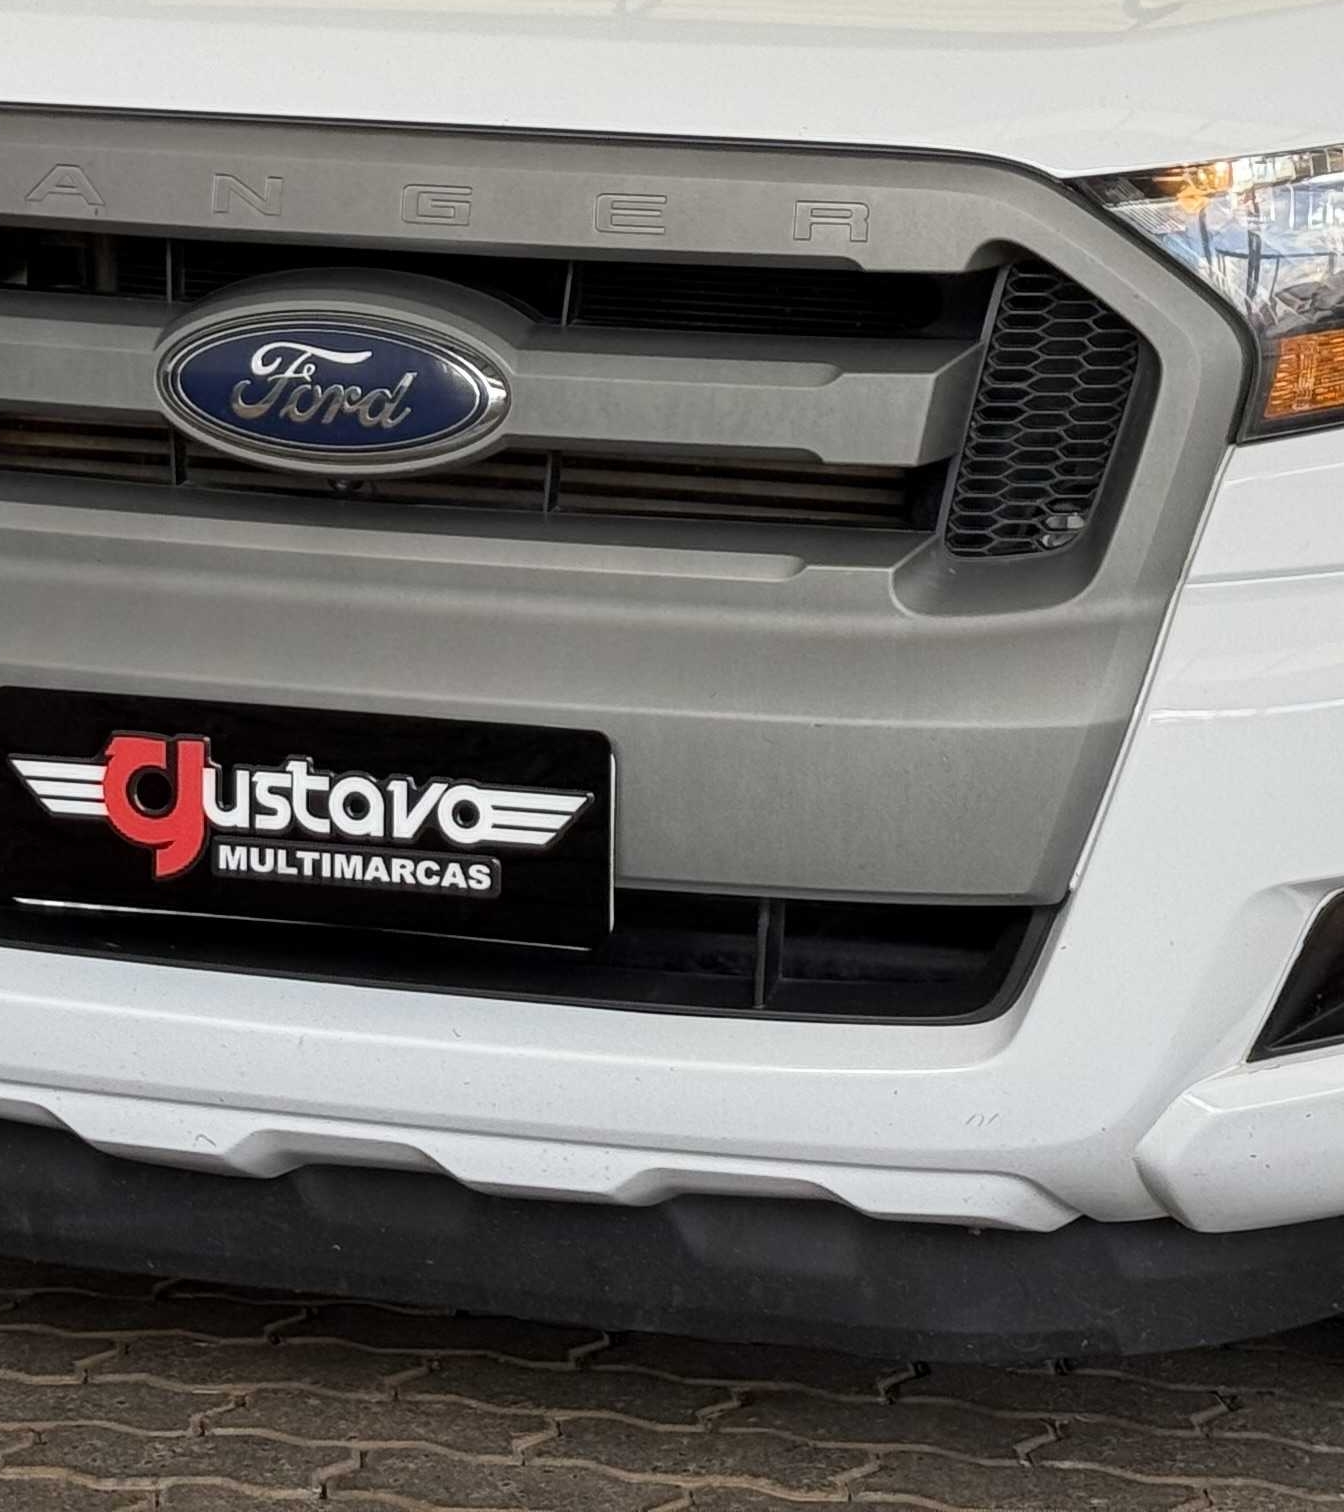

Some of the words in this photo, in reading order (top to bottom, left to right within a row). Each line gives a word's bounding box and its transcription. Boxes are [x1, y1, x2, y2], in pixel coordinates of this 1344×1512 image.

[231, 341, 418, 428] Ford
[103, 735, 493, 880] gustavo
[217, 844, 493, 891] MULTIMARCAS
